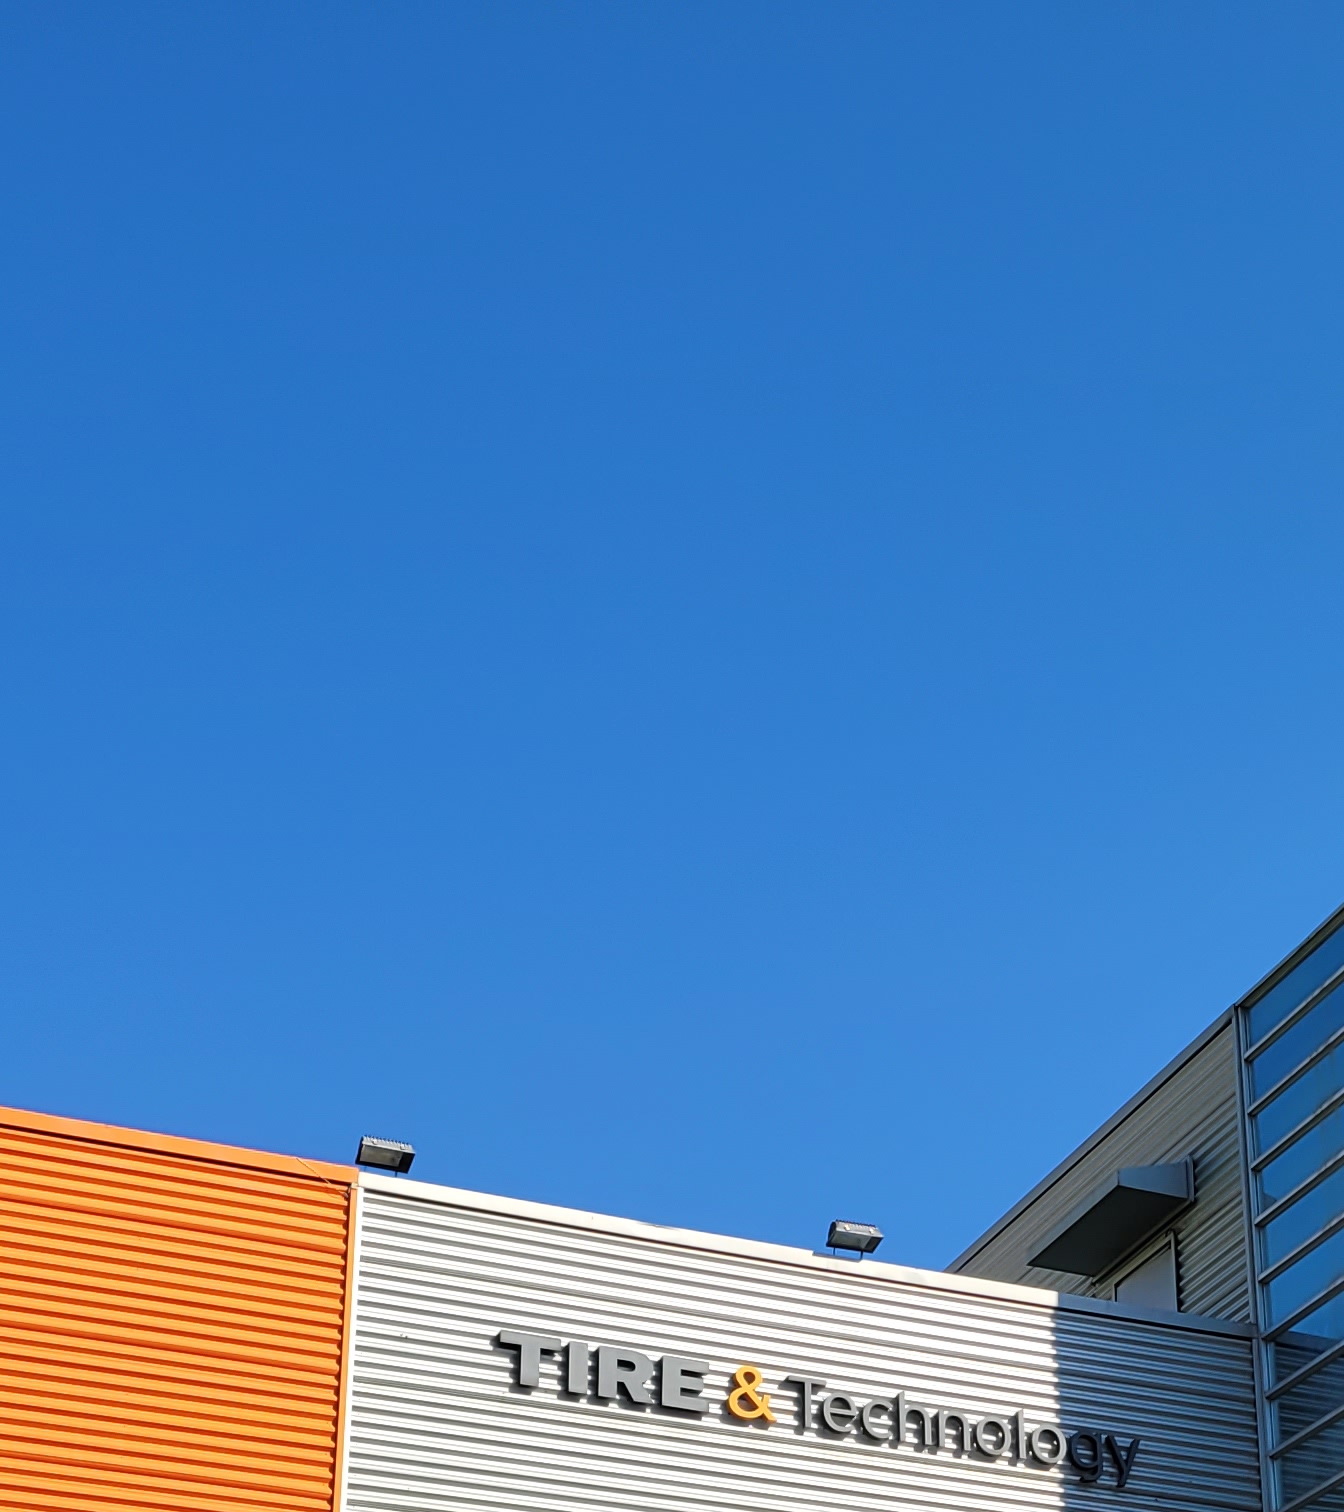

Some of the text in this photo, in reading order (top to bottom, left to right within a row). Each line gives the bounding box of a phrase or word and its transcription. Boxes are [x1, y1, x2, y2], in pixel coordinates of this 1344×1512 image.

[500, 1330, 1141, 1489] TIRE & Technology
